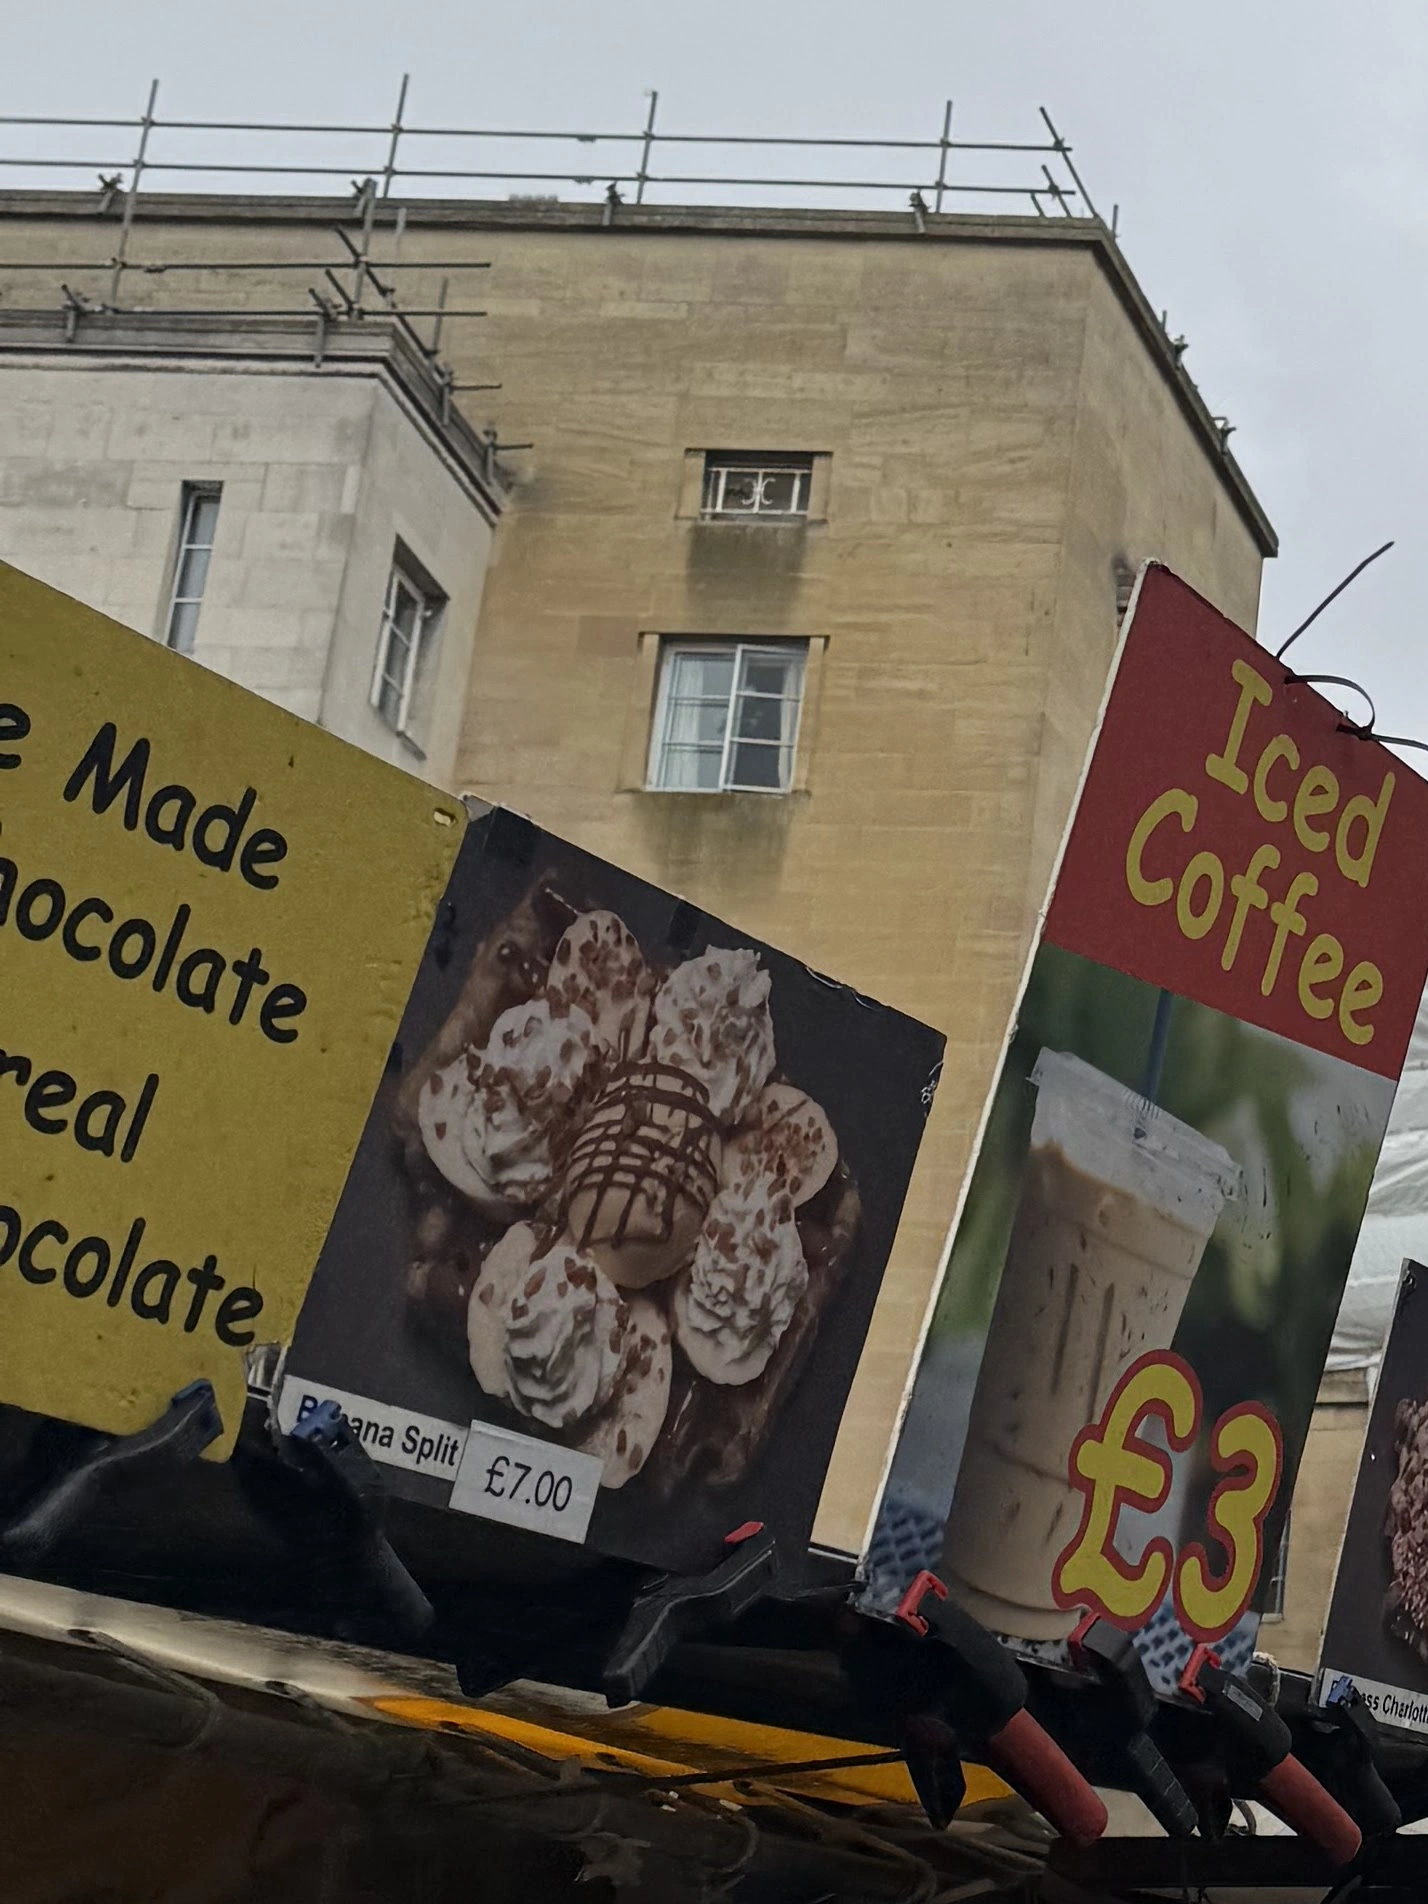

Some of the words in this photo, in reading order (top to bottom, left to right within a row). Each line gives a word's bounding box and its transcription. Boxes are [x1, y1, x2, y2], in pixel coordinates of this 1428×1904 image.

[63, 722, 288, 890] Made
[1204, 657, 1397, 890] Iced
[1125, 789, 1385, 1048] Coffee
[401, 1425, 459, 1467] Split
[484, 1456, 573, 1512] £7.00
[1053, 1350, 1284, 1644] £3
